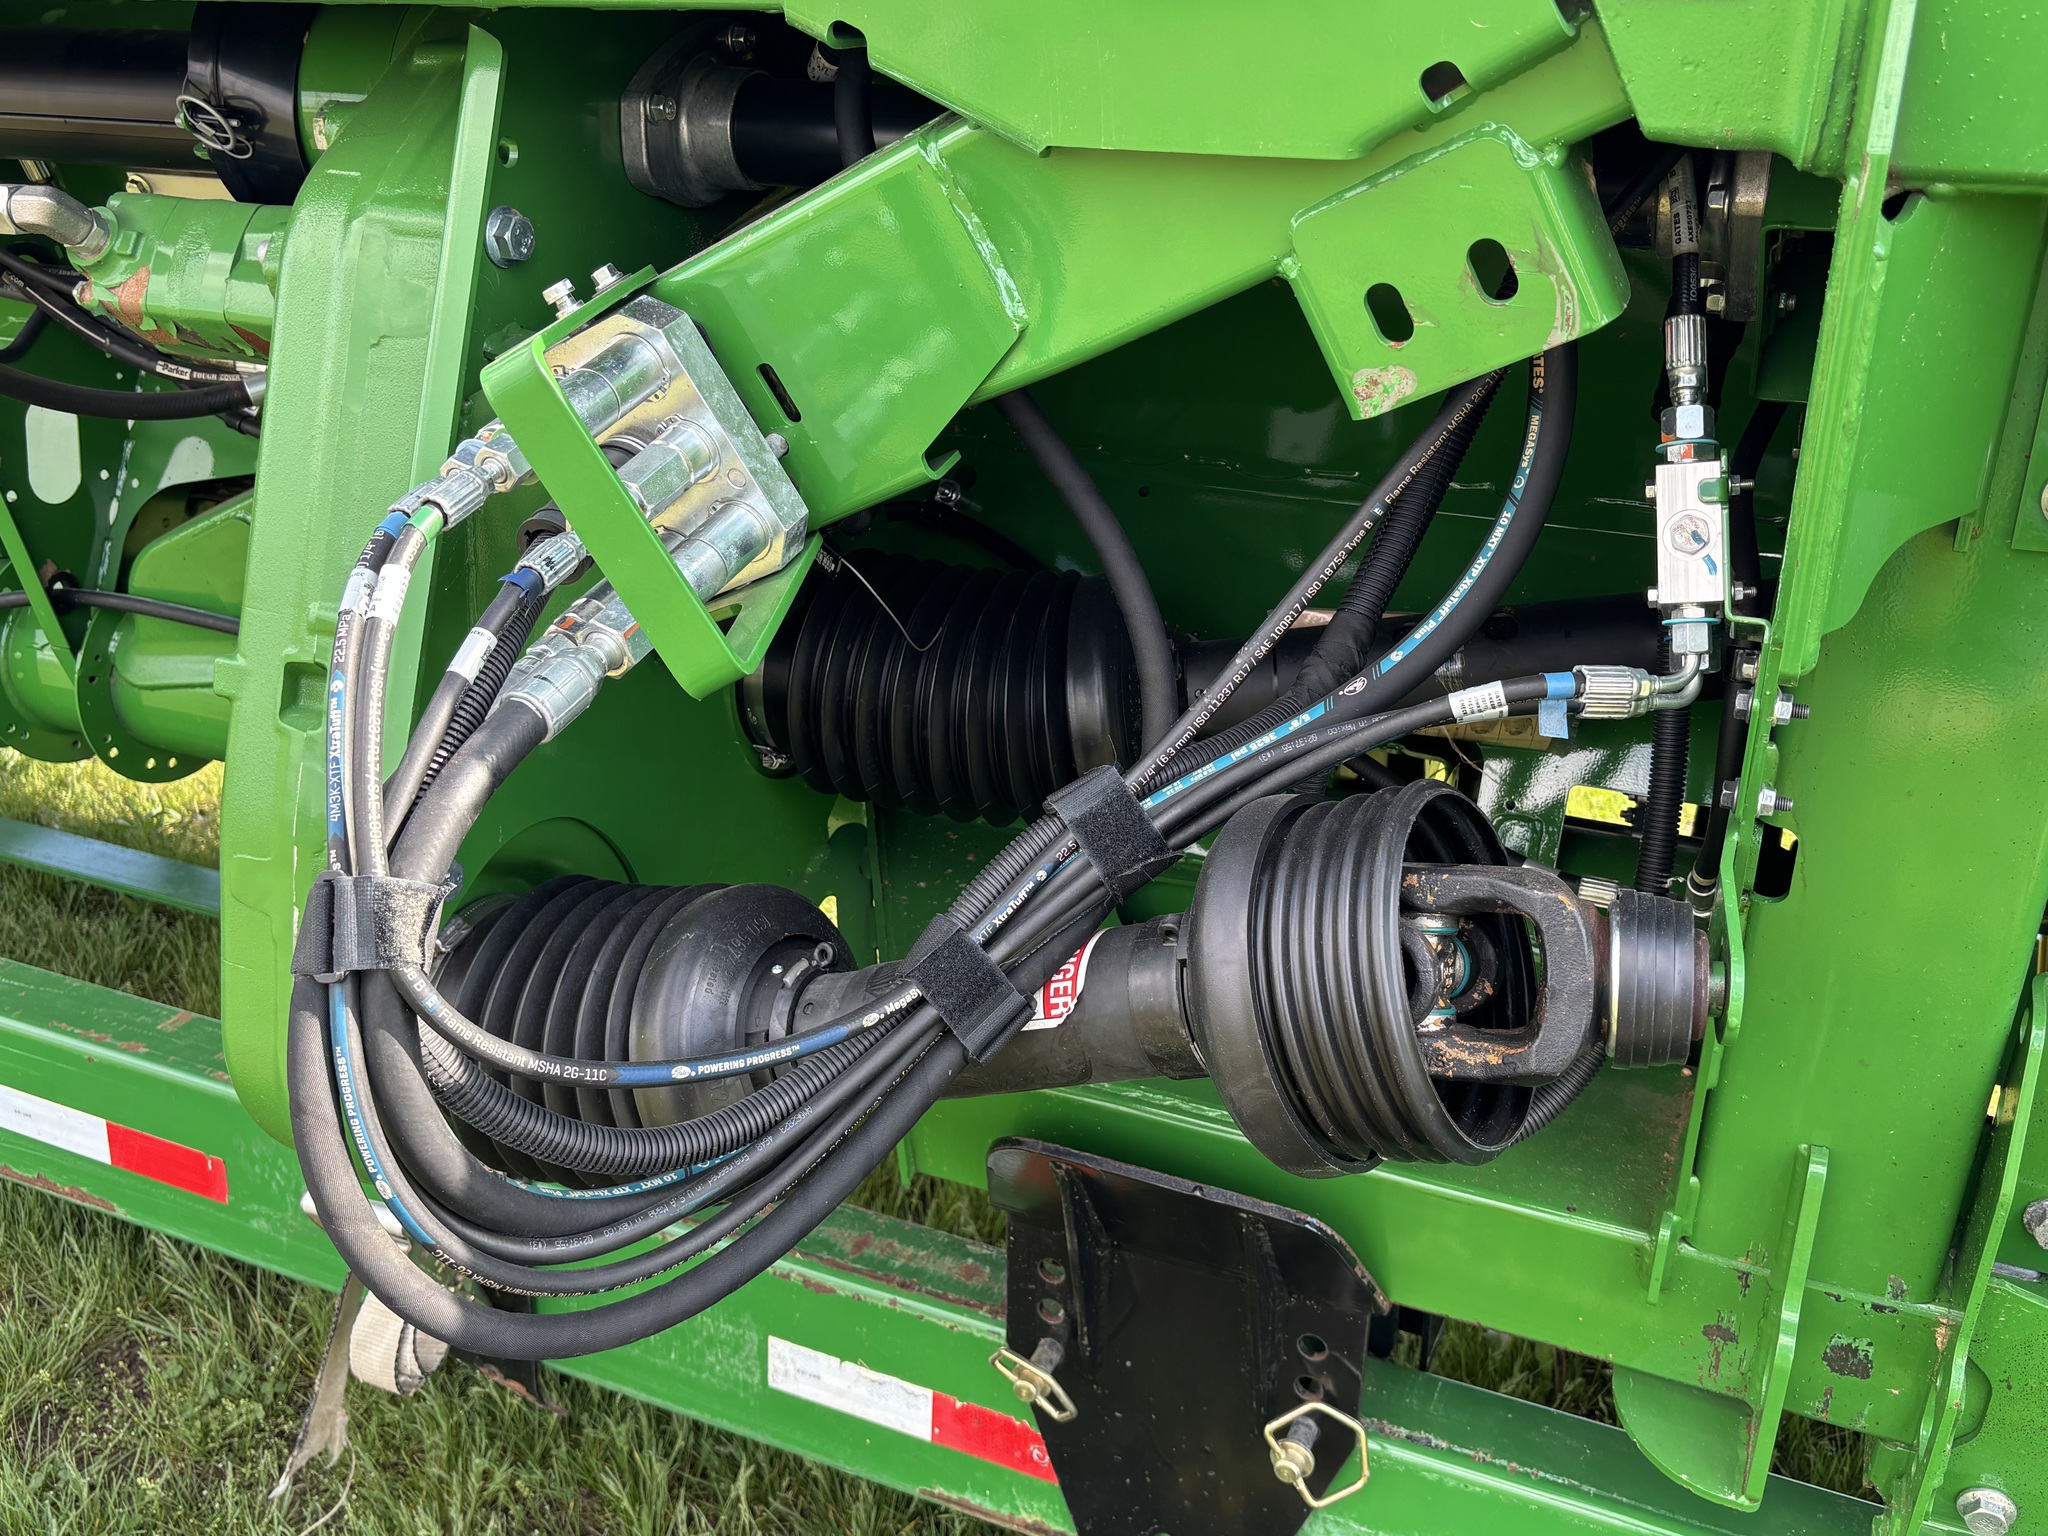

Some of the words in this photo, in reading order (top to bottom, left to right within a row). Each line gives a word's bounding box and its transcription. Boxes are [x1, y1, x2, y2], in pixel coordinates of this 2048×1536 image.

[1674, 212, 1682, 244] GATES
[160, 362, 190, 381] Parker
[192, 370, 219, 381] TOUGH
[1500, 511, 1513, 525] 10
[1470, 554, 1488, 578] XTP
[1156, 745, 1177, 768] (6.3
[1175, 725, 1198, 754] mm)
[1194, 708, 1211, 730] ISO
[1208, 682, 1236, 712] 11237
[1233, 663, 1252, 686] R17
[1254, 638, 1275, 661] SAE
[1270, 602, 1304, 643] 100R17
[1305, 579, 1323, 600] ISO
[1319, 551, 1349, 583] 18752
[1344, 528, 1367, 553] Type
[1363, 518, 1375, 531] B
[1385, 475, 1412, 505] Flame
[1409, 429, 1451, 476] Resistant
[1447, 401, 1475, 432] MSHA
[340, 613, 352, 637] MPa
[1413, 620, 1437, 640] Plus
[333, 637, 348, 664] 22.5
[1249, 732, 1278, 753] 3625
[329, 760, 344, 823] 4M3K-XTF
[367, 782, 382, 810] SAE
[1055, 840, 1078, 862] 22.5
[414, 981, 425, 993] B
[438, 1008, 474, 1041] Flame
[472, 1033, 528, 1067] Resistant
[527, 1058, 561, 1077] MSHA
[563, 1065, 608, 1082] 2G-11C
[697, 1056, 746, 1076] POWERING
[349, 1116, 378, 1175] POWERING
[663, 1172, 679, 1184] 10
